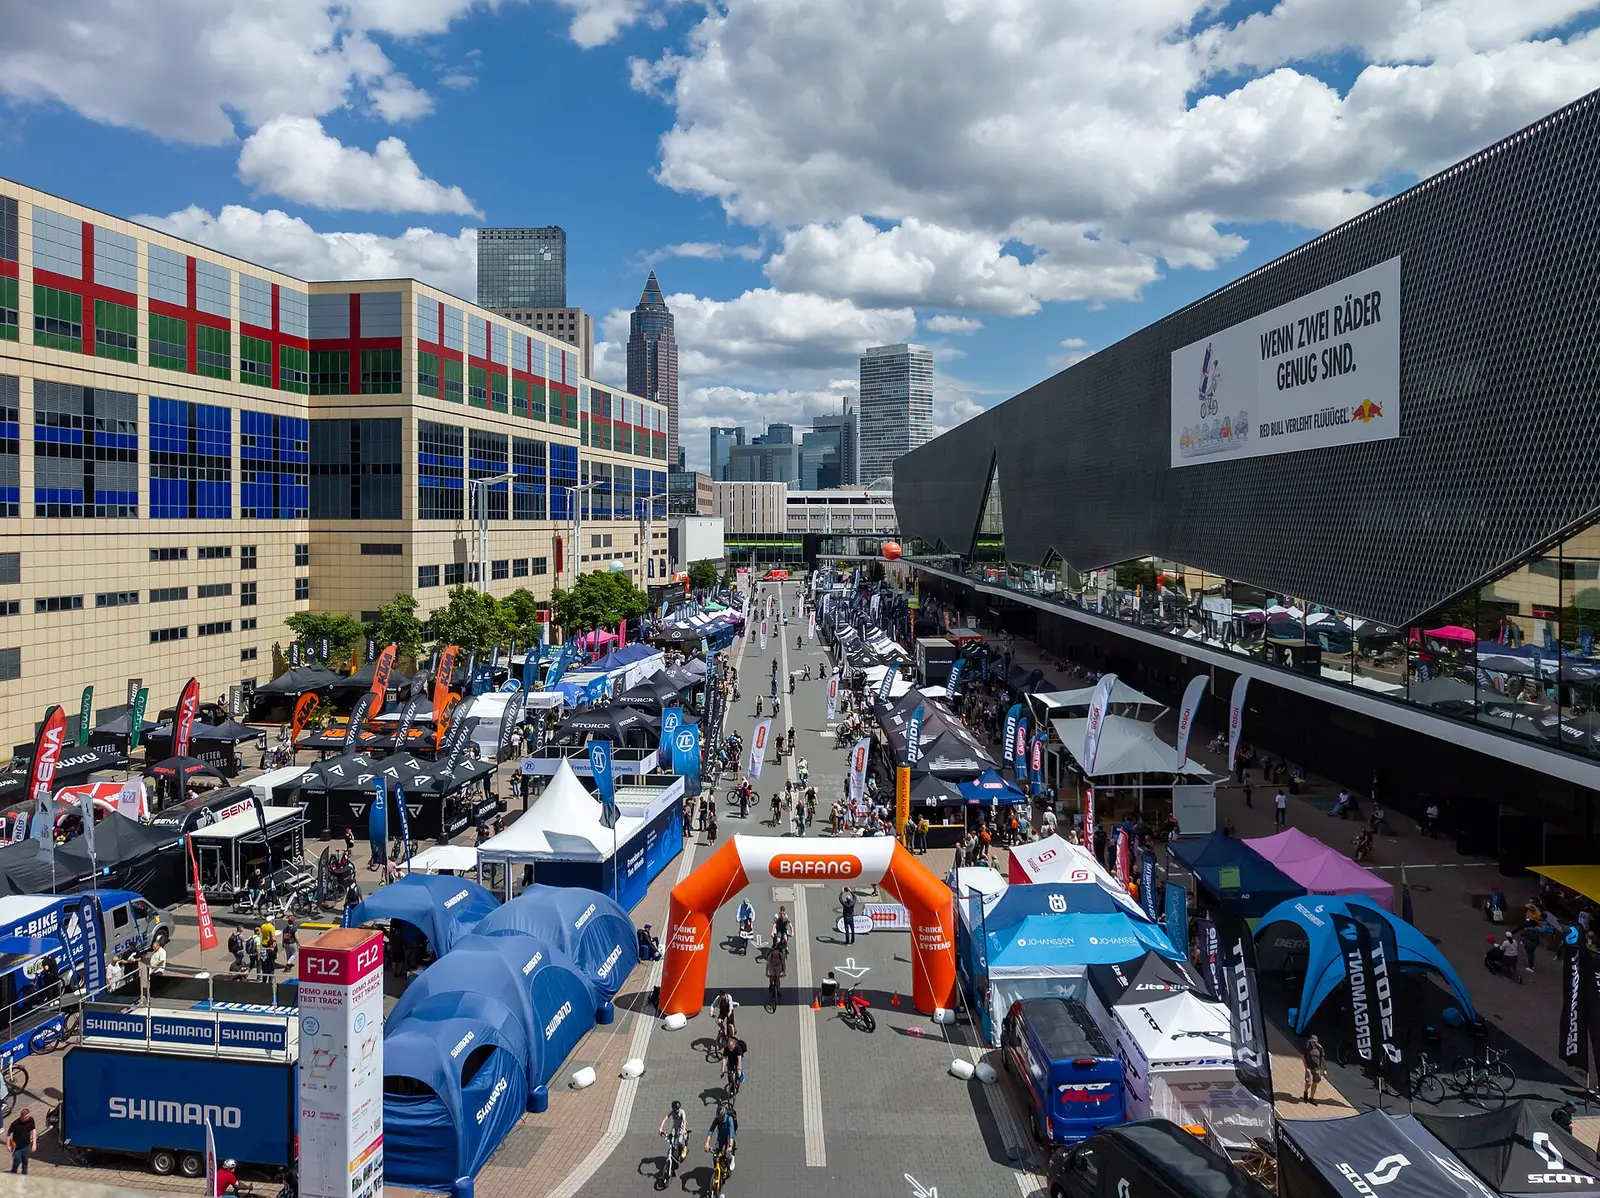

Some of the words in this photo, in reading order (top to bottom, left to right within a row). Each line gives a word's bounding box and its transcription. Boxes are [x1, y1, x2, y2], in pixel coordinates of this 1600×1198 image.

[1260, 322, 1294, 360] WENN
[1297, 309, 1329, 349] ZWEI
[1333, 290, 1381, 337] RÄDER
[1276, 352, 1318, 391] GENUG
[1321, 342, 1357, 380] SIND.
[1259, 424, 1270, 438] RED
[1271, 420, 1284, 436] BULL
[1285, 414, 1313, 434] VERLEIHT
[378, 653, 393, 686] KTM
[440, 653, 455, 686] KTM
[880, 668, 895, 701] pinion
[946, 666, 960, 700] pinion
[82, 693, 91, 730] owuru
[134, 696, 144, 732] owuru
[297, 697, 317, 725] KTM
[349, 701, 368, 739] RAYMON
[399, 702, 417, 741] RAYMON
[440, 697, 459, 729] KTM
[503, 701, 518, 743] RAYMON
[618, 715, 639, 727] STORCK
[1091, 707, 1101, 730] BOSCH
[1181, 708, 1191, 730] BOSCH
[1232, 707, 1240, 729] BOSCH
[178, 695, 197, 757] SENA
[1004, 716, 1016, 761] pinion
[447, 726, 470, 771] RAYMON
[907, 718, 919, 763] pinion
[33, 726, 63, 799] SENA
[221, 800, 253, 820] SENA
[780, 860, 852, 874] BAFANG
[443, 889, 469, 908] SHIMANO
[14, 910, 58, 938] E-BIKE
[574, 903, 596, 930] SHIMANO
[673, 925, 697, 934] E-BIKE
[918, 925, 943, 933] E-BIKE
[671, 943, 705, 952] SYSTEMS
[672, 934, 695, 943] DRIVE
[919, 934, 942, 942] DRIVE
[919, 942, 951, 951] SYSTEMS
[307, 957, 340, 976] F12
[357, 944, 379, 972] F12
[522, 951, 543, 976] SHIMANO
[597, 944, 623, 979] SHIMANO
[299, 987, 321, 995] DEMO
[323, 989, 342, 997] AREA
[352, 982, 367, 996] DEMO
[367, 973, 380, 986] AREA
[352, 991, 365, 1004] TEST
[365, 982, 381, 995] TRACK
[319, 996, 343, 1005] TRACK
[86, 1018, 144, 1033] SHIMANO
[153, 1024, 213, 1038] SHIMANO
[545, 1001, 573, 1040] SHIMANO
[1139, 1006, 1163, 1033] FELT
[222, 1029, 282, 1043] SHIMANO
[450, 1030, 475, 1059] SHIMANO
[1151, 1060, 1196, 1068] FELT
[1058, 1082, 1111, 1092] FELT
[109, 1096, 242, 1129] SHIMANO
[475, 1076, 508, 1125] SHIMANO
[302, 1110, 316, 1118] F12
[1527, 1173, 1595, 1185] SCOTT
